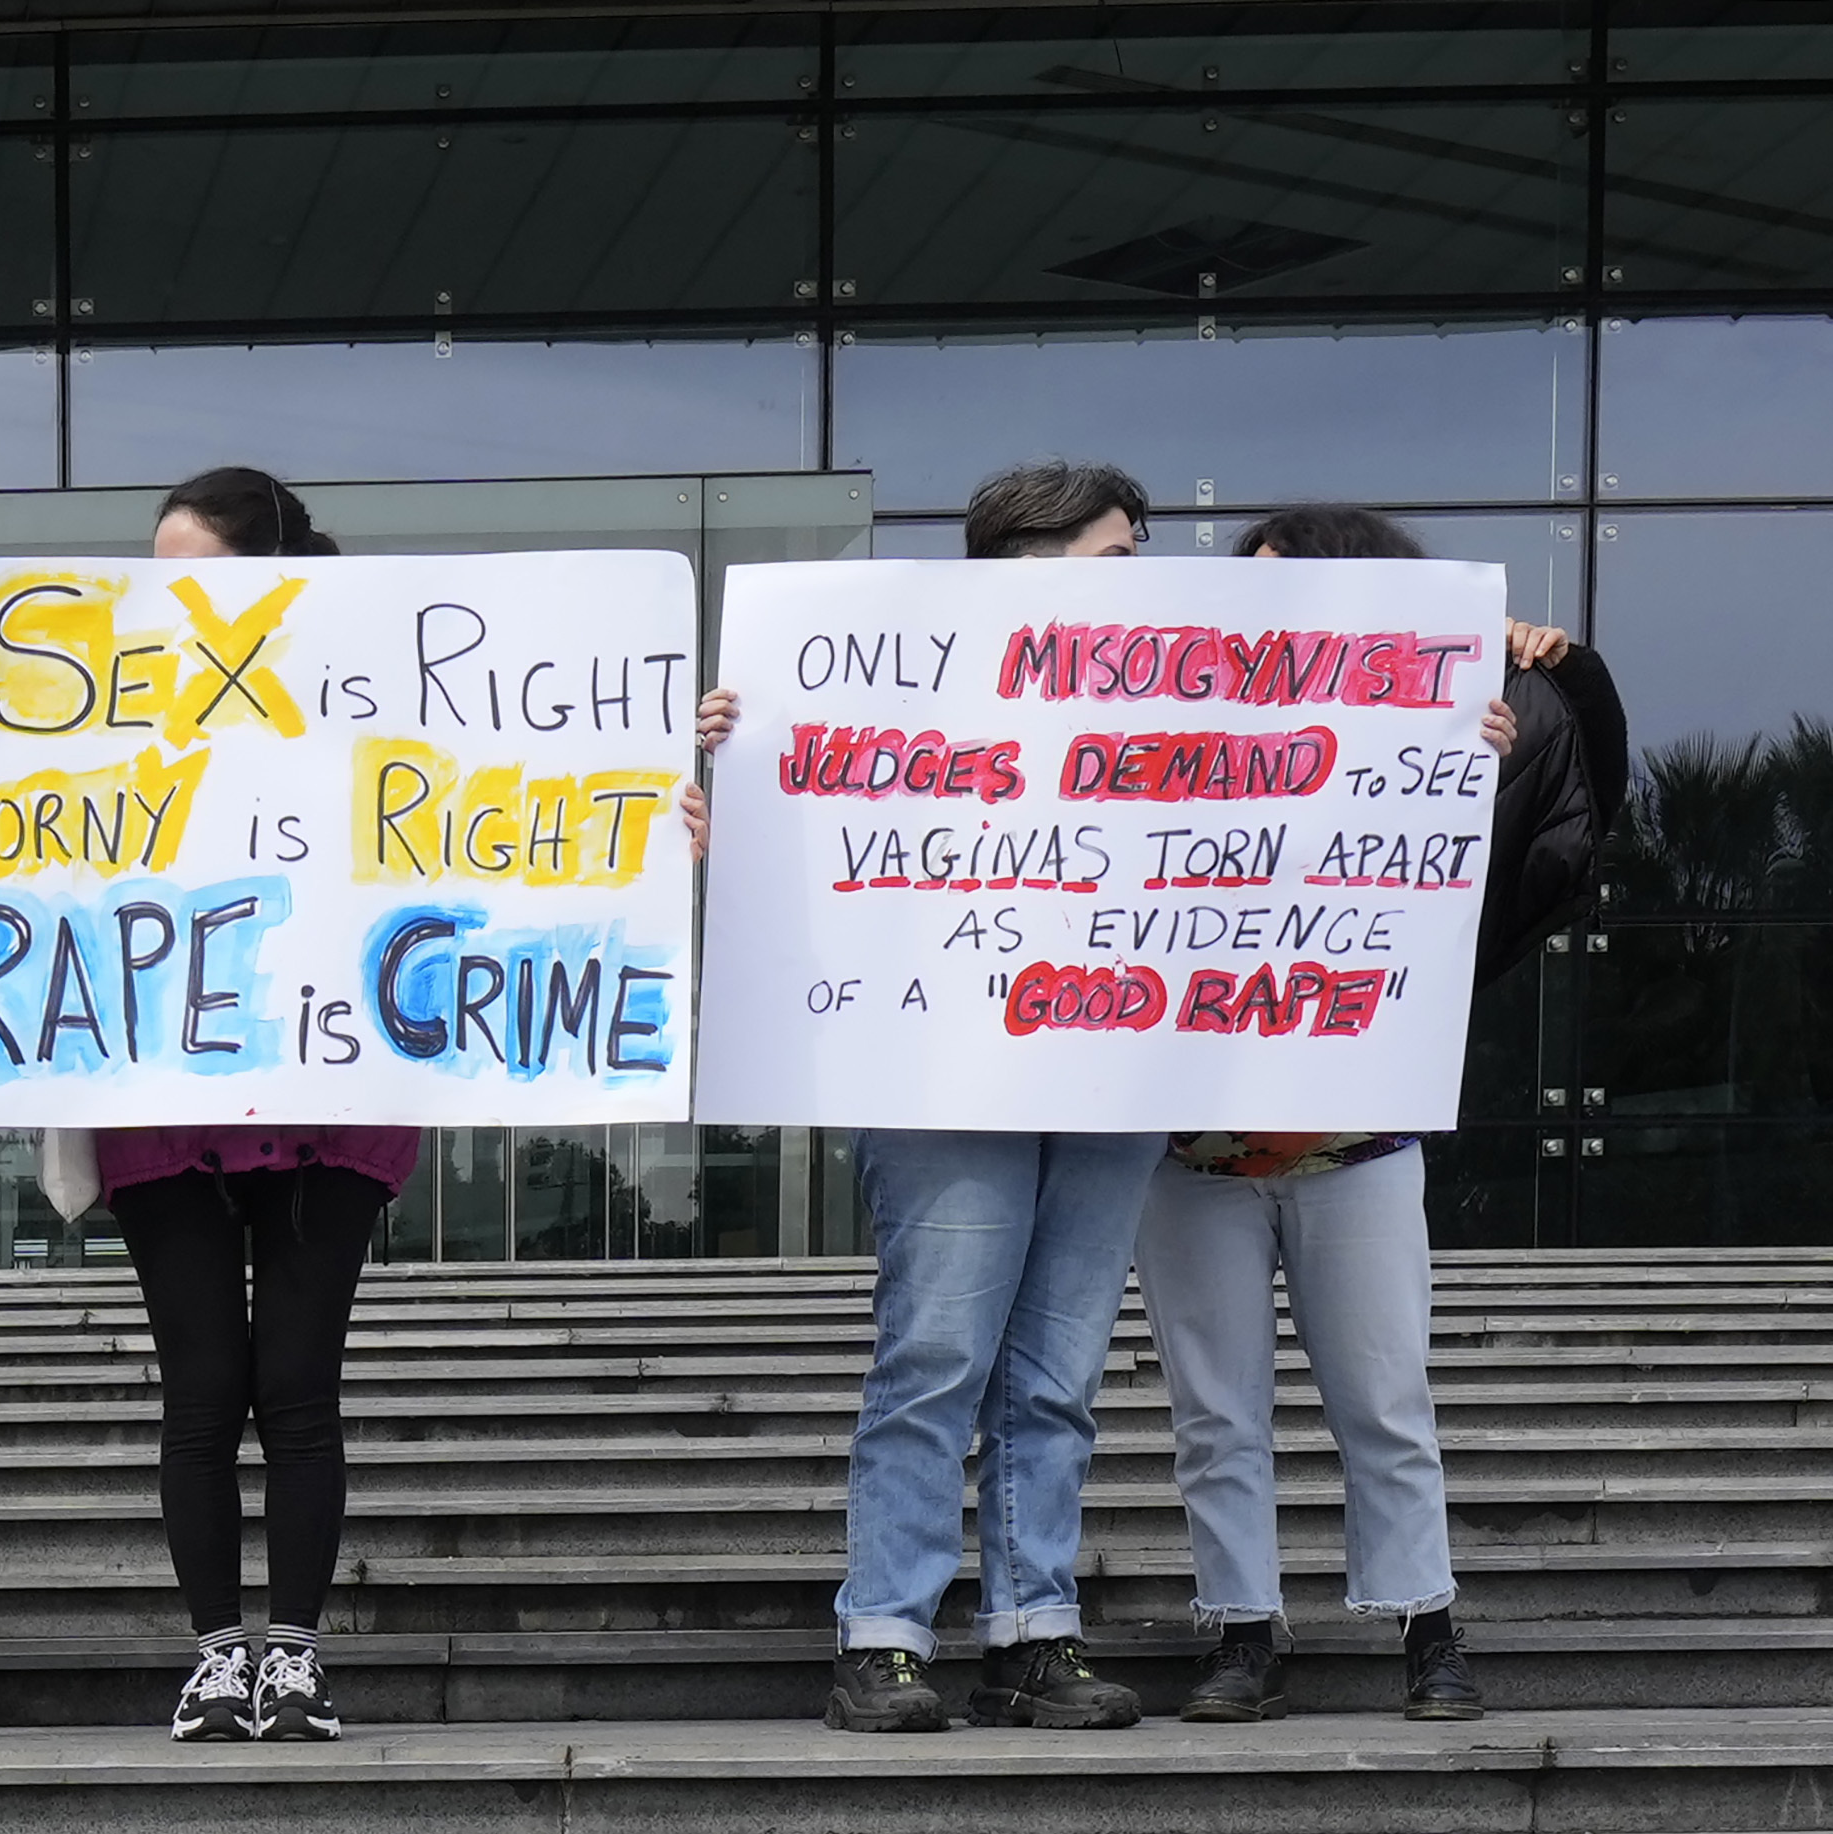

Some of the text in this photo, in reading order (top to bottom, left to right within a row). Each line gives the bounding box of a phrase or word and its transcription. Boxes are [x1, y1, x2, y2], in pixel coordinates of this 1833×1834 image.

[417, 603, 686, 735] RIGHT
[797, 628, 1474, 703] ONLY MISOGYNIST
[785, 730, 1021, 797] JUDGES
[1068, 732, 1330, 797] DEMAND
[1398, 746, 1496, 799] SEE
[378, 761, 658, 875] RIGHT
[1147, 823, 1286, 881] TORN
[1322, 833, 1482, 886] APART
[942, 905, 1406, 955] AS EVIDENCE
[377, 917, 675, 1077] CRIME
[807, 979, 862, 1016] OF
[901, 977, 928, 1013] A
